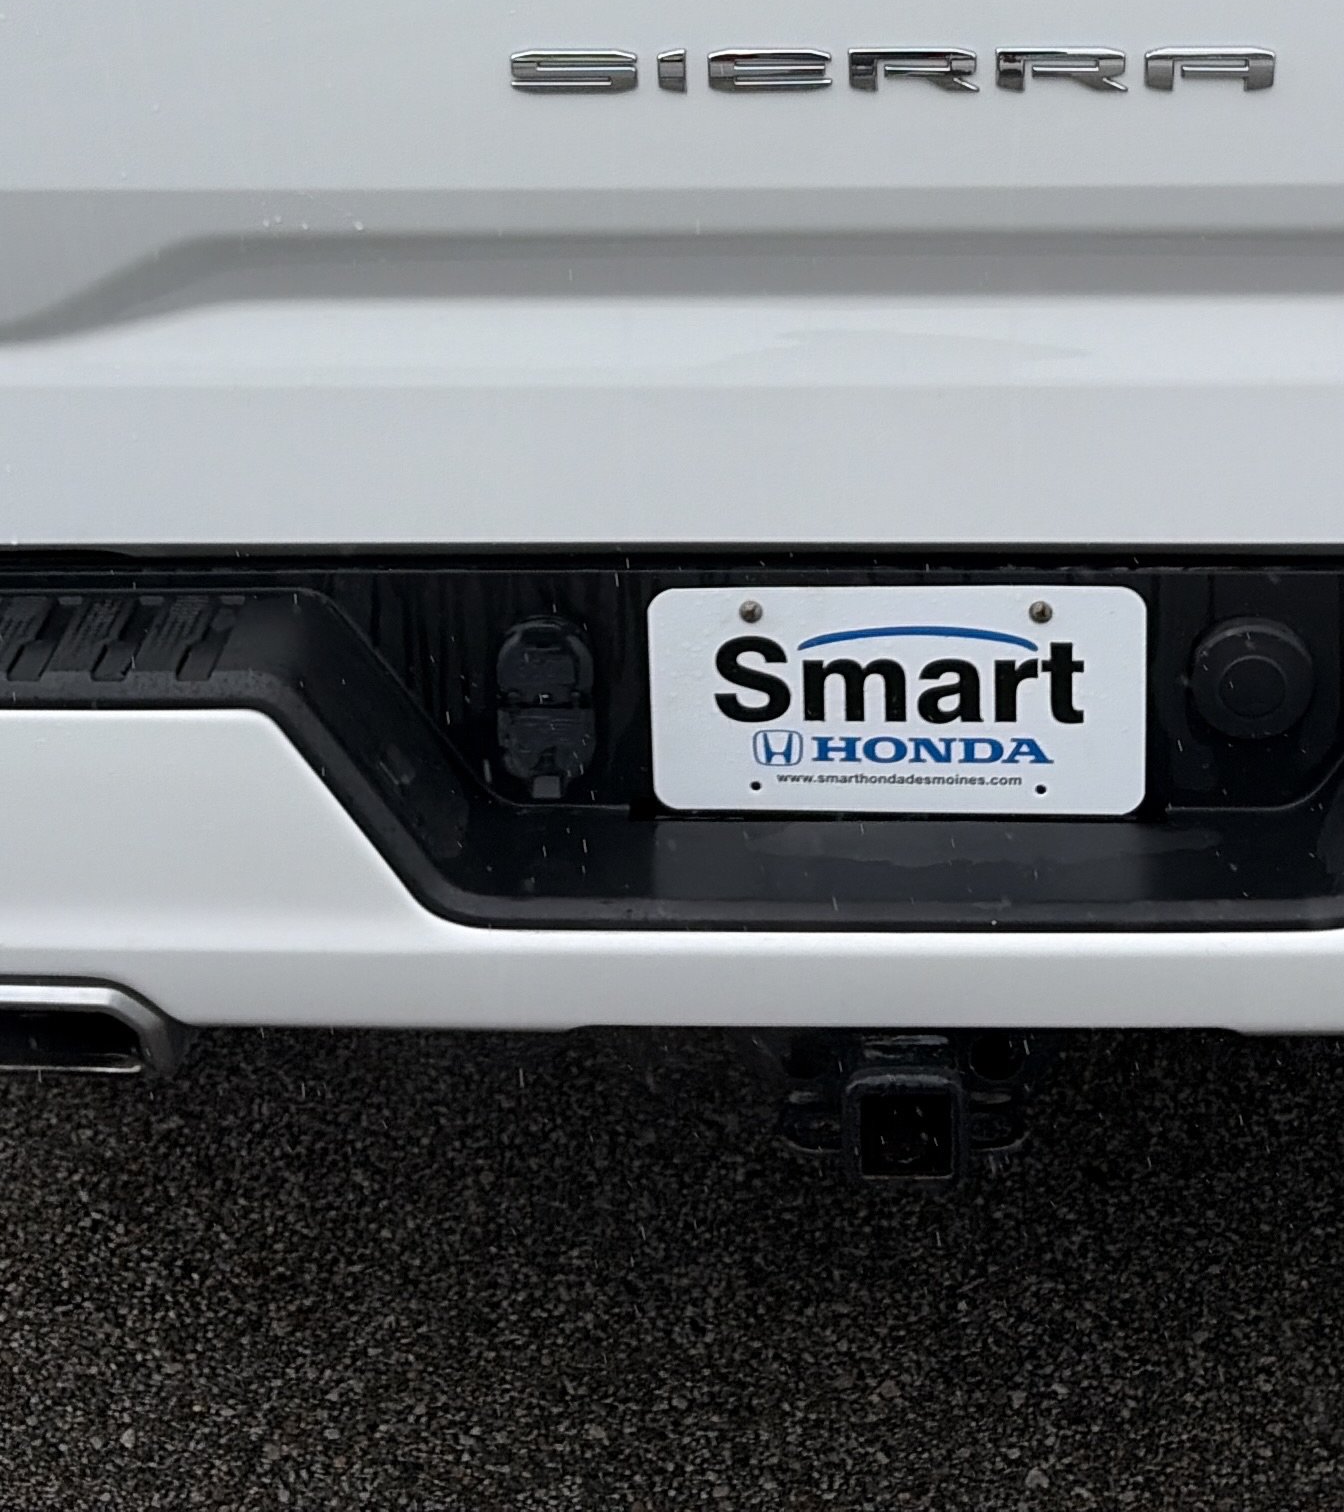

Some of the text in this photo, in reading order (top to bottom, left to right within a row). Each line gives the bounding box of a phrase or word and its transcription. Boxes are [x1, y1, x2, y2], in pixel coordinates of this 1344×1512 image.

[510, 47, 1277, 93] SIERRA
[714, 635, 1085, 725] Smart
[812, 735, 1054, 764] HONDA
[776, 772, 1023, 787] www.smarthondadesmoines.com
